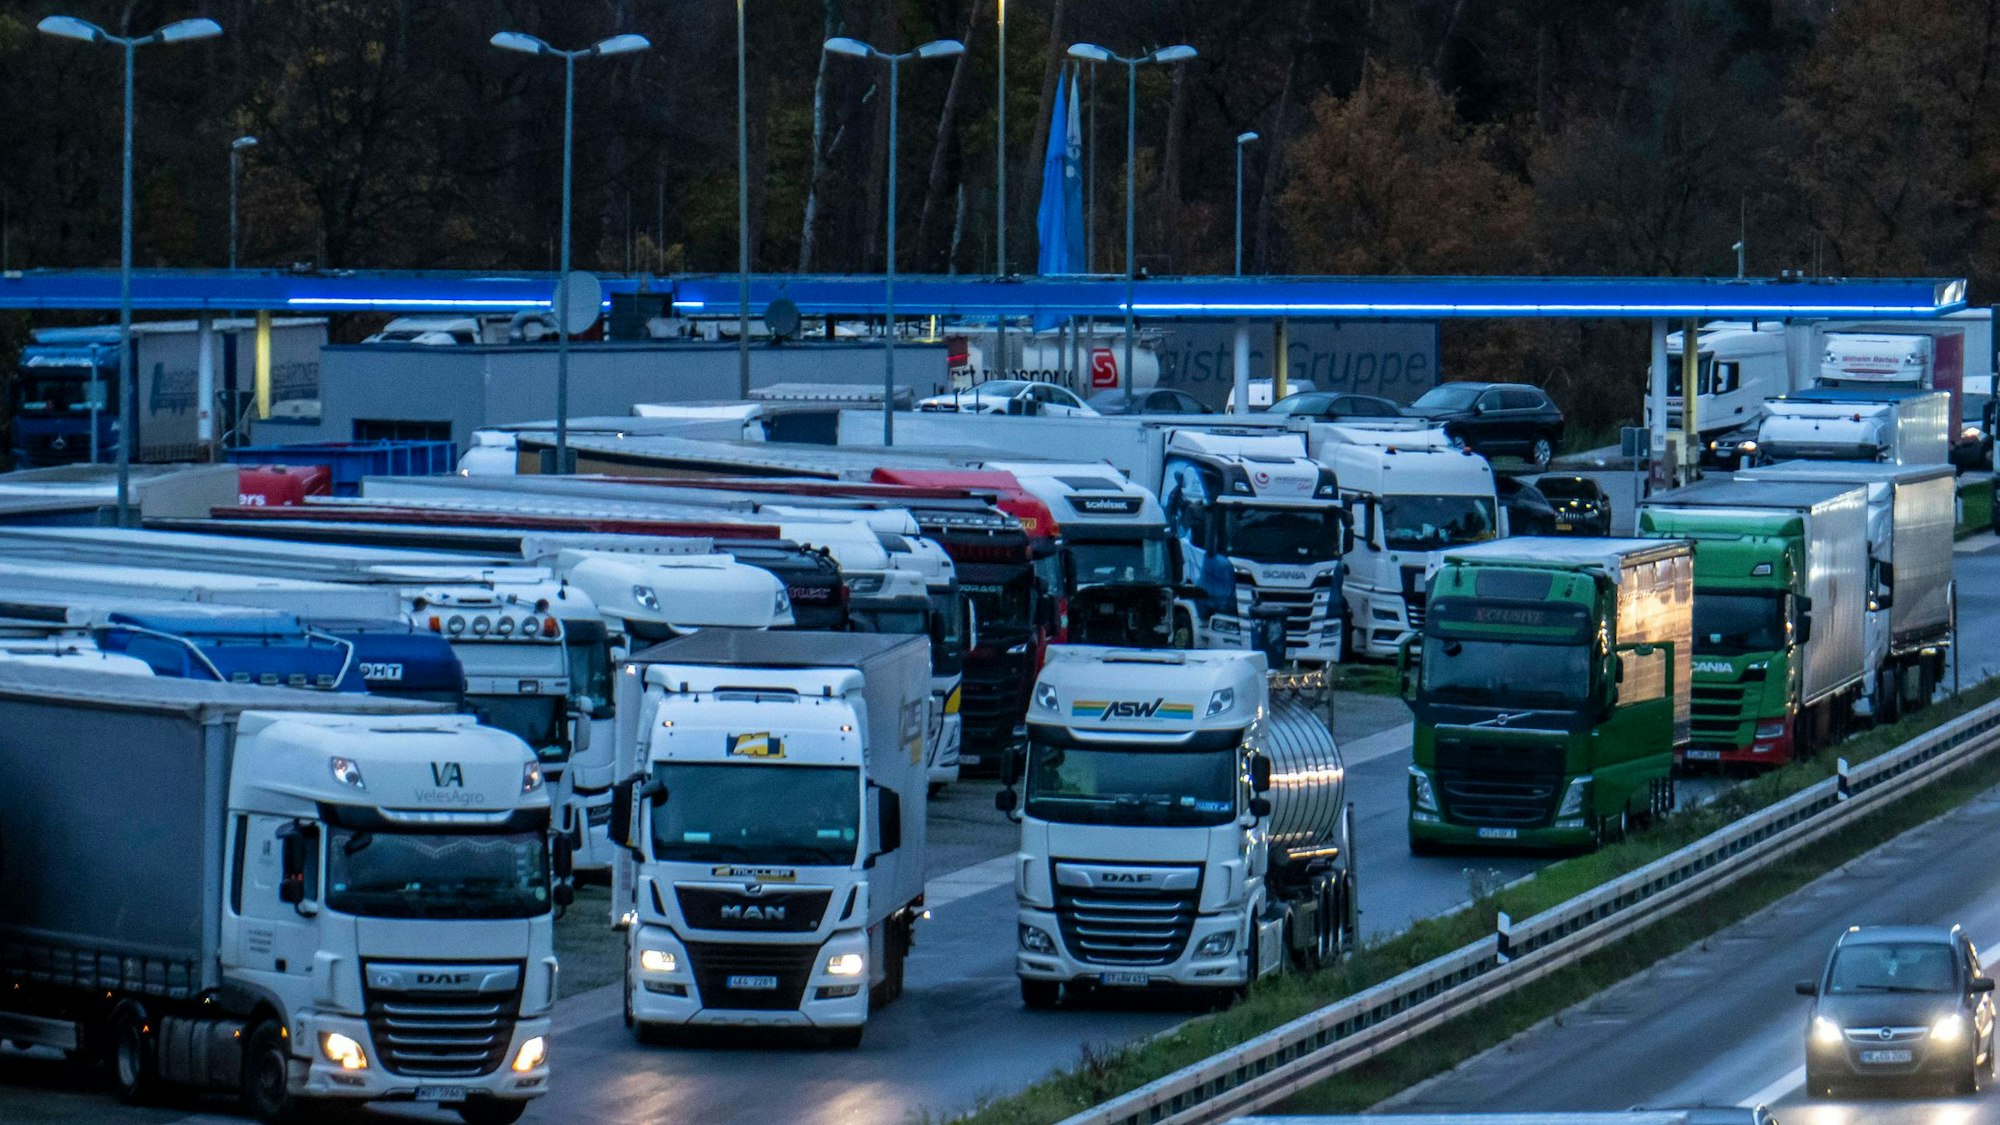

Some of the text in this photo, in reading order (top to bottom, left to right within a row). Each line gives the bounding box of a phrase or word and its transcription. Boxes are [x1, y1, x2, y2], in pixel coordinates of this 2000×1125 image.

[1262, 569, 1307, 580] SCANIA
[1100, 697, 1164, 721] ASW
[414, 787, 485, 806] VelesAgro
[1102, 872, 1153, 883] DAF
[721, 904, 785, 920] MAN
[416, 973, 471, 985] DAF
